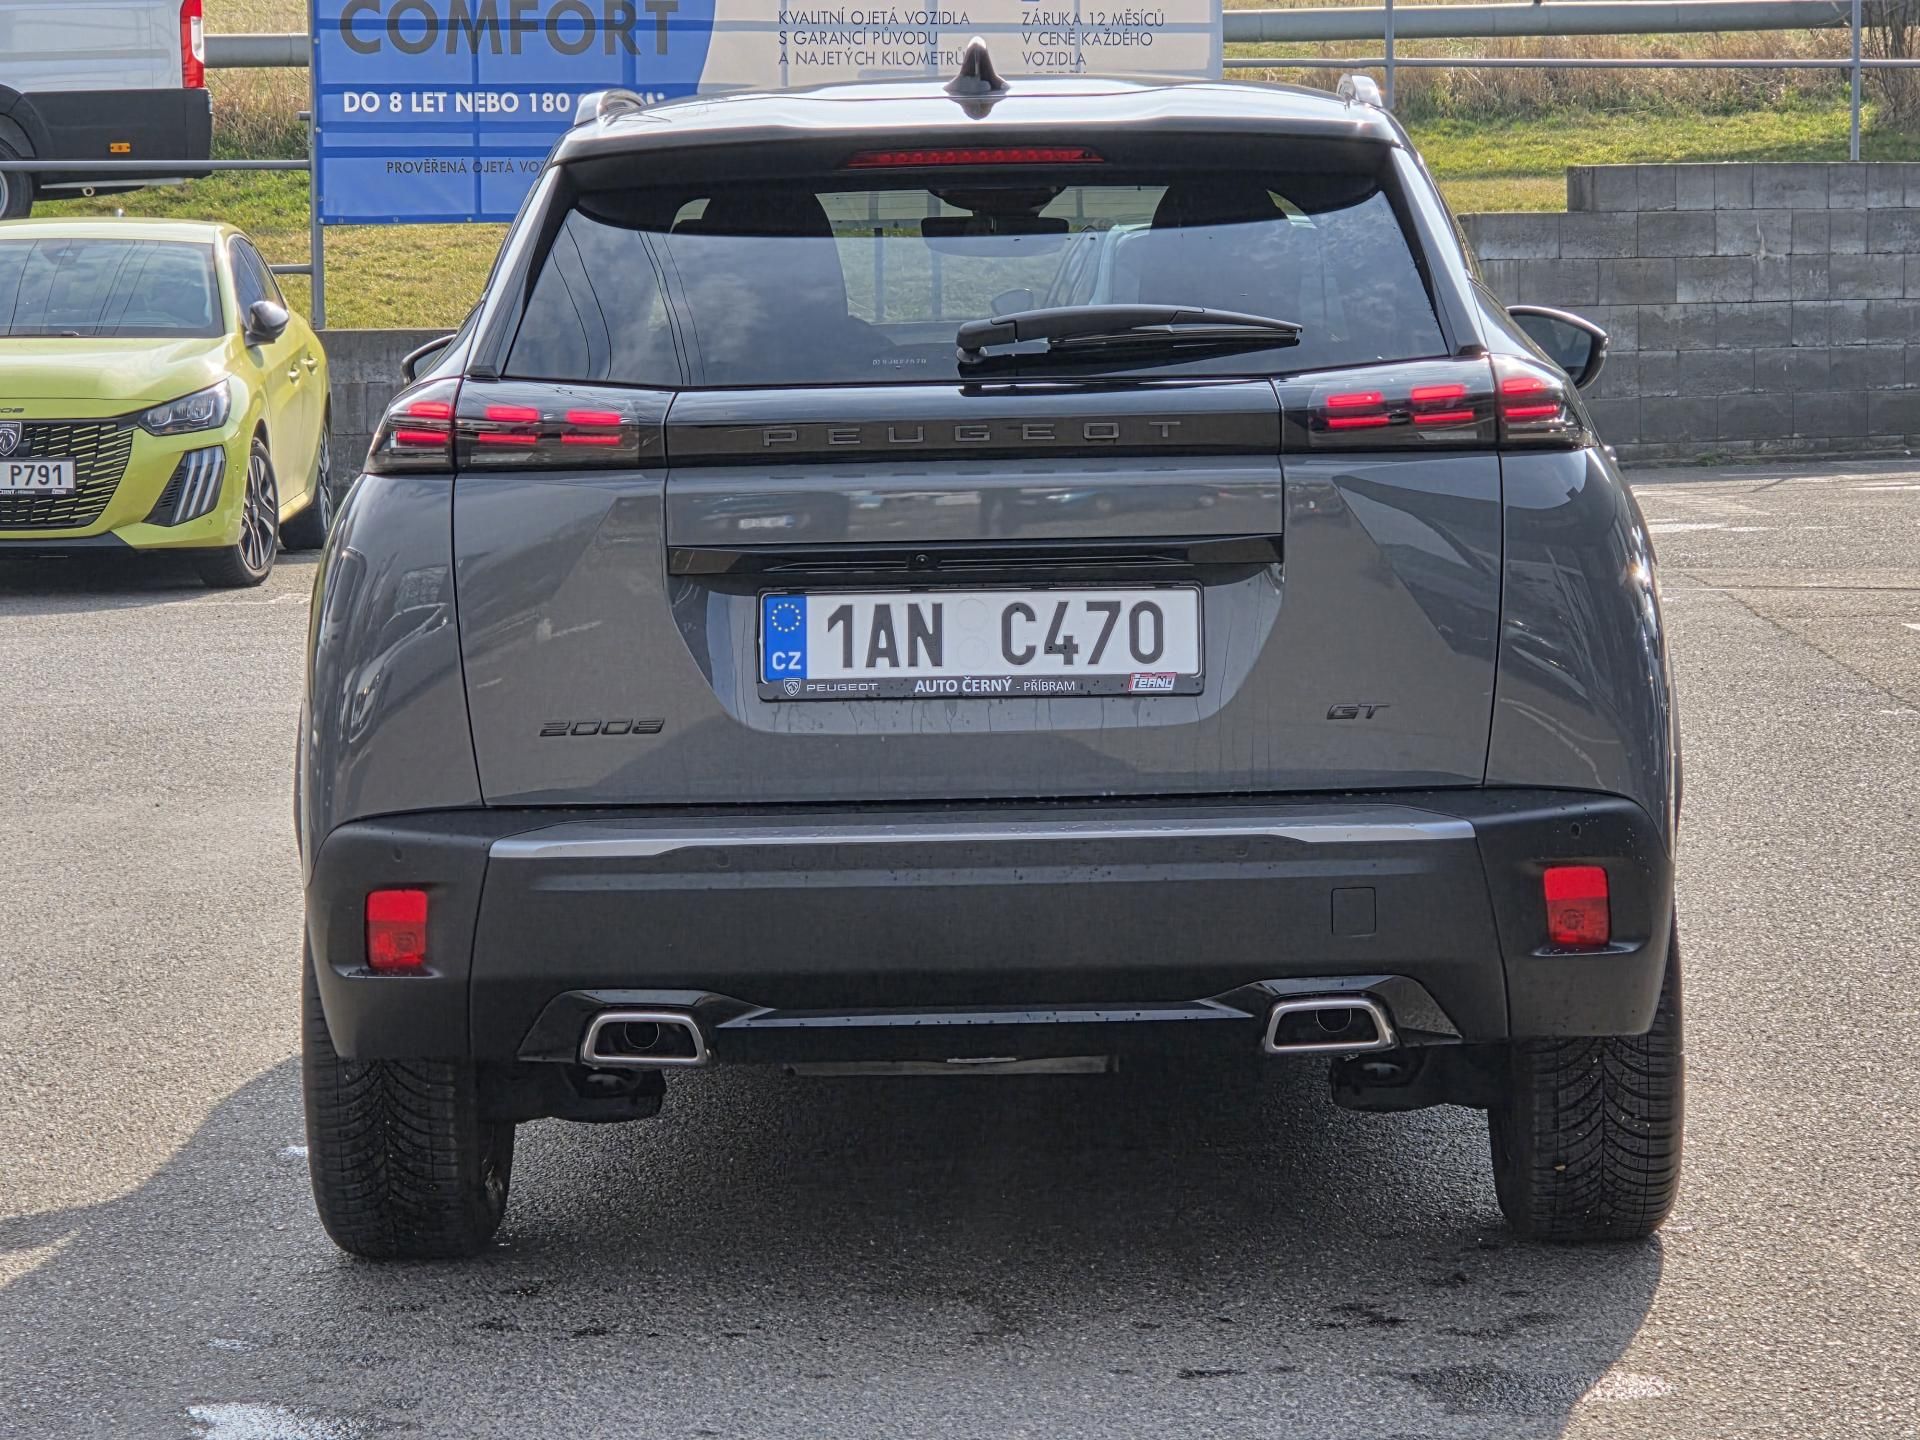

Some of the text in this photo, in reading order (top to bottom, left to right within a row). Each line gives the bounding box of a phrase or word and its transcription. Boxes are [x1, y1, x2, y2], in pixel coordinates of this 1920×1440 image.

[778, 7, 970, 25] KVALITNÍ OJETÁ VOZIDLA
[1022, 8, 1164, 27] ZÁRUKA 12 MĚSÍCŮ
[340, 0, 679, 55] COMFORT
[778, 27, 938, 46] S GARANCÍ PŮVODU
[1022, 28, 1153, 46] V CENĚ KAŽDÉHO
[778, 52, 789, 65] A
[795, 48, 875, 65] NAJETÝCH
[1022, 51, 1087, 66] VOZIDLA
[343, 92, 380, 113] DO
[389, 92, 402, 113] 8
[411, 92, 447, 113] LET
[456, 92, 519, 113] NEBO
[529, 92, 570, 113] 180
[386, 158, 546, 174] PROVĚŘENÁ OJETÁ VO
[763, 421, 1181, 447] PEUGEOT
[10, 464, 62, 486] P791
[827, 600, 1165, 668] 1AN C470
[771, 651, 802, 670] CZ
[806, 682, 879, 692] PEUGEOT
[914, 680, 957, 694] AUTO
[962, 676, 1012, 693] ČERNÝ
[1023, 680, 1076, 692] PŘÍBRAM
[1326, 703, 1391, 720] GT
[539, 718, 665, 737] 2008
